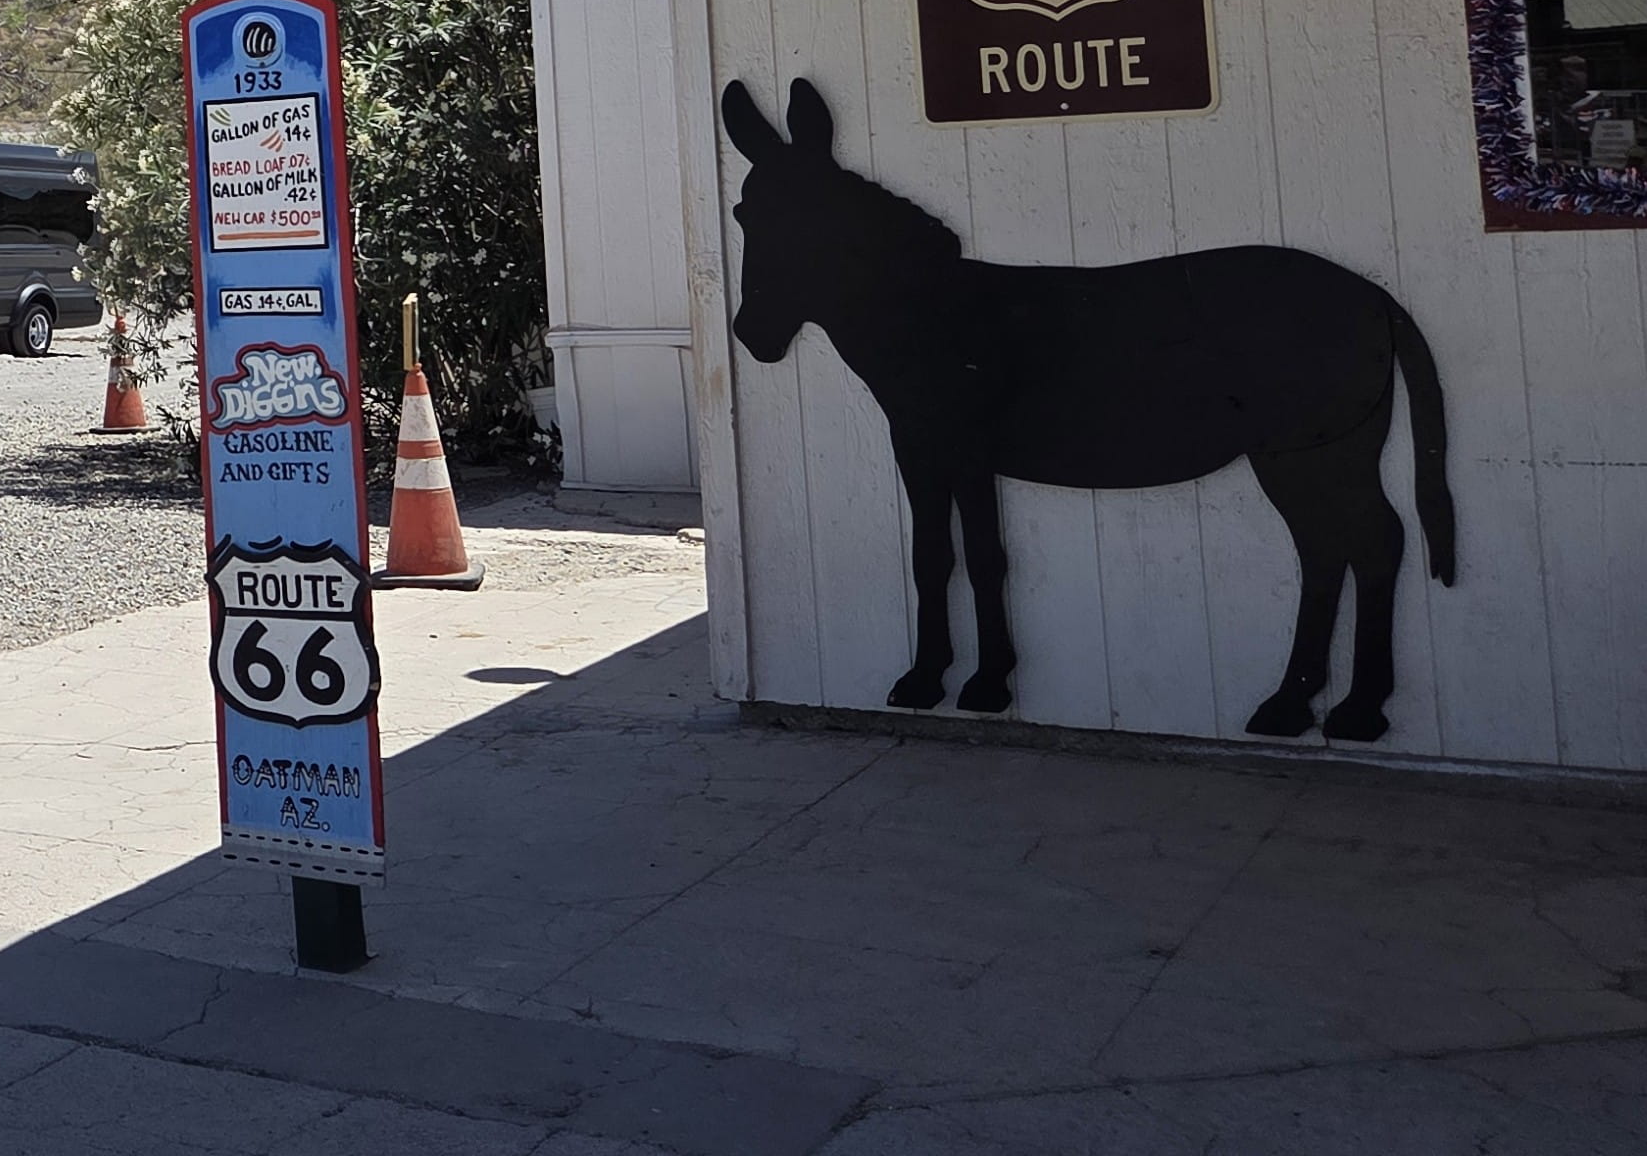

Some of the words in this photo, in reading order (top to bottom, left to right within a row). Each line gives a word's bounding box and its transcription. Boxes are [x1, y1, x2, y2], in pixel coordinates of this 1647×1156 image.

[978, 36, 1150, 95] ROUTE
[234, 71, 283, 94] 1933
[211, 120, 259, 144] GALLON
[263, 111, 279, 129] OF
[282, 104, 311, 124] GAS
[212, 160, 251, 177] BREAD
[256, 156, 286, 175] LOAF
[212, 180, 263, 199] GALLON
[266, 174, 284, 192] OF
[284, 167, 318, 186] MILK
[214, 212, 241, 225] NEW
[244, 211, 266, 224] CAR
[224, 293, 253, 310] GAS
[223, 430, 334, 455] GASOLINE
[219, 462, 263, 483] AND
[267, 461, 330, 485] GIFTS
[237, 571, 346, 609] ROUTE
[232, 619, 346, 706] 66
[232, 755, 361, 799] OATMAN
